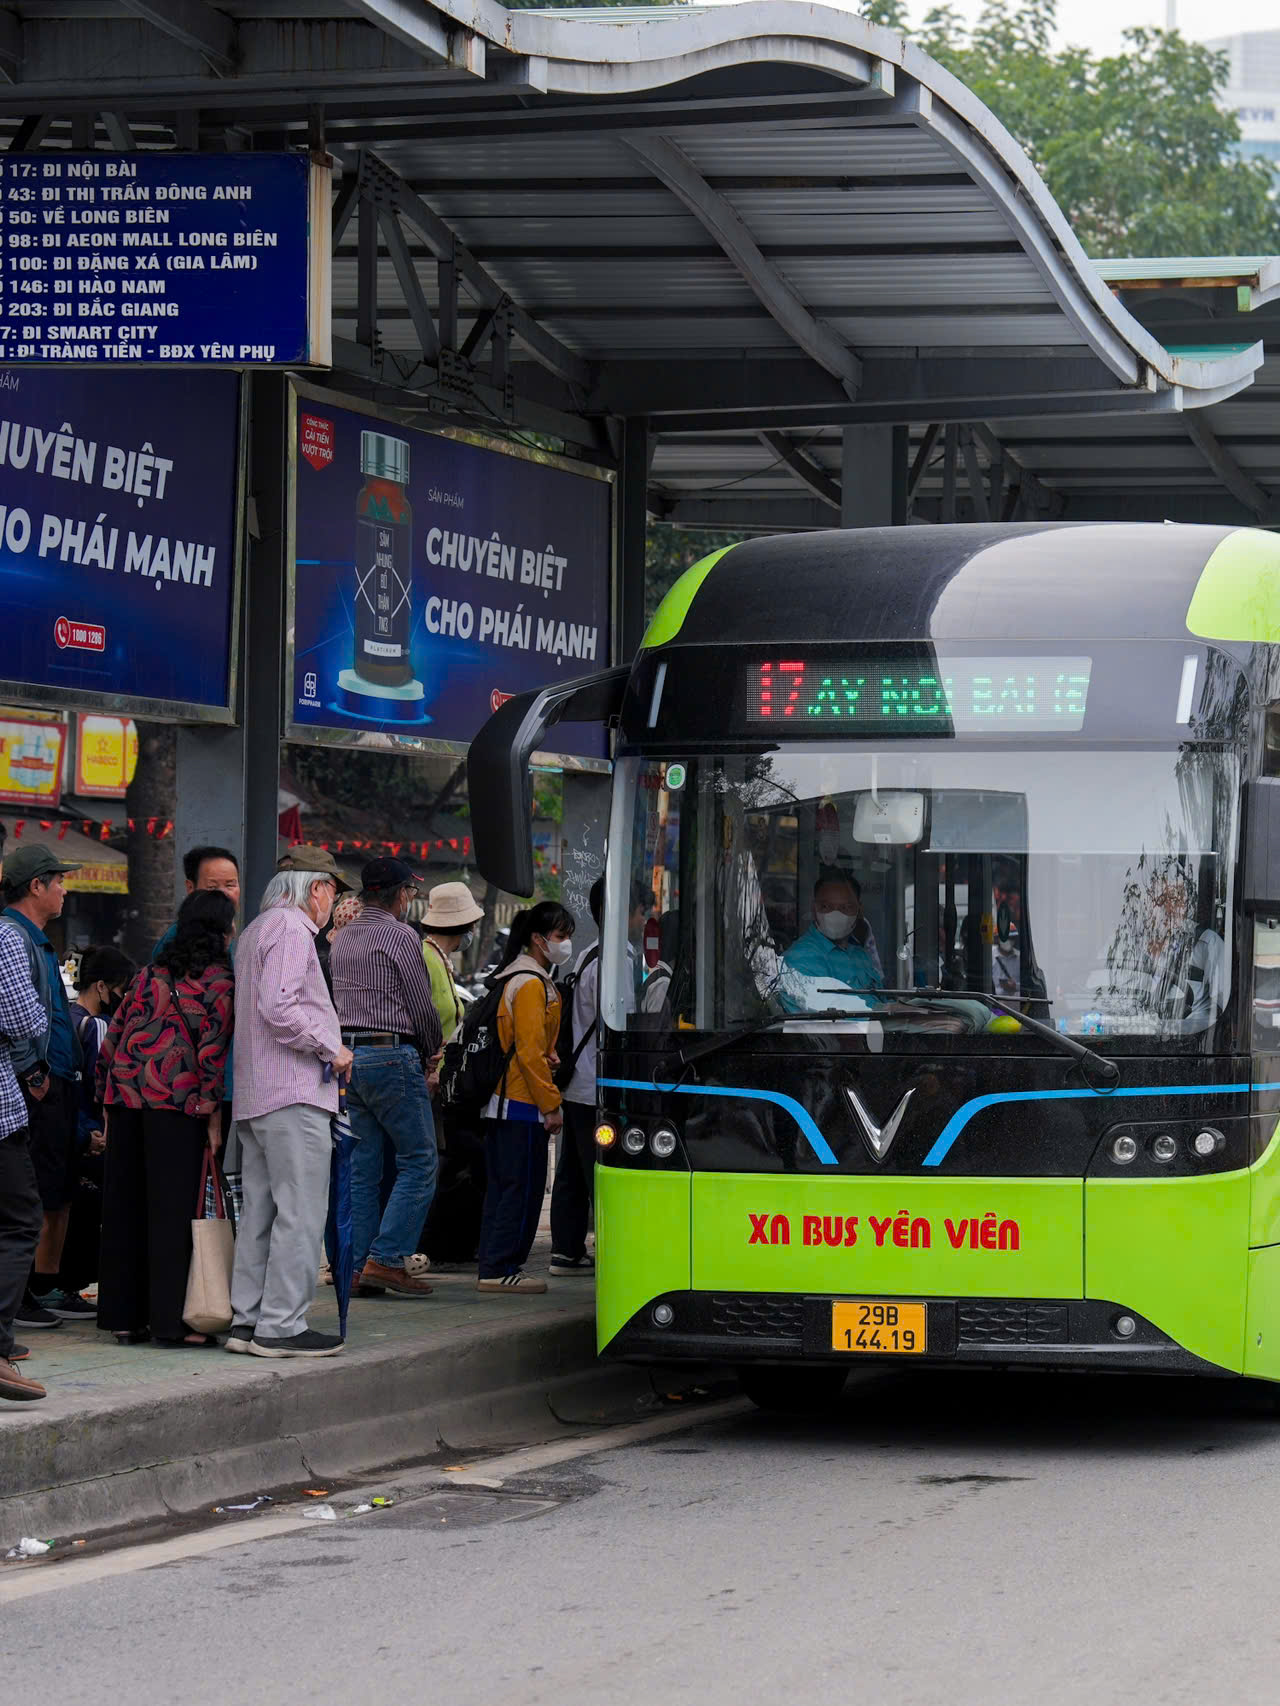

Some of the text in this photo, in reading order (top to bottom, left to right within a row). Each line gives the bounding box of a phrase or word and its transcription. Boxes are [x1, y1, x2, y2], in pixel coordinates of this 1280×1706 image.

[10, 163, 38, 177] 17:
[42, 163, 62, 177] ĐI
[67, 160, 100, 180] NỘI
[105, 160, 137, 177] BÀI
[8, 182, 252, 203] 43: ĐI THỊ TRẤN ĐÔNG ANH
[9, 205, 170, 224] 50: VỀ LONG BIÊN
[8, 229, 278, 248] 98: ĐI AEON MALL LONG BIÊN
[9, 252, 258, 273] 100: ĐI ĐẶNG XÁ (GIA LÂM)
[9, 274, 166, 294] 146: ĐI HÀO NAM
[8, 297, 179, 317] 203: ĐI BẮC GIANG
[22, 326, 42, 340] ĐI
[47, 326, 112, 340] SMART
[117, 326, 158, 340] CITY
[17, 345, 35, 358] ĐI
[40, 341, 98, 358] TRÀNG
[102, 339, 142, 358] TIỀN
[160, 345, 195, 358] BĐX
[200, 342, 234, 358] YÊN
[239, 345, 275, 361] PHỤ
[102, 442, 174, 508] BIỆT
[38, 513, 119, 570] PHÁI
[124, 531, 216, 591] MẠNH
[376, 552, 392, 569] NHUNG
[425, 527, 568, 599] CHUYÊN BIỆT
[424, 595, 598, 666] CHO PHÁI MẠNH
[760, 663, 804, 716] 17
[803, 1215, 859, 1247] BUS
[868, 1209, 931, 1249] YÊN
[944, 1212, 1020, 1250] VIÊN
[858, 1305, 898, 1326] 29B
[844, 1328, 915, 1350] 144.19
